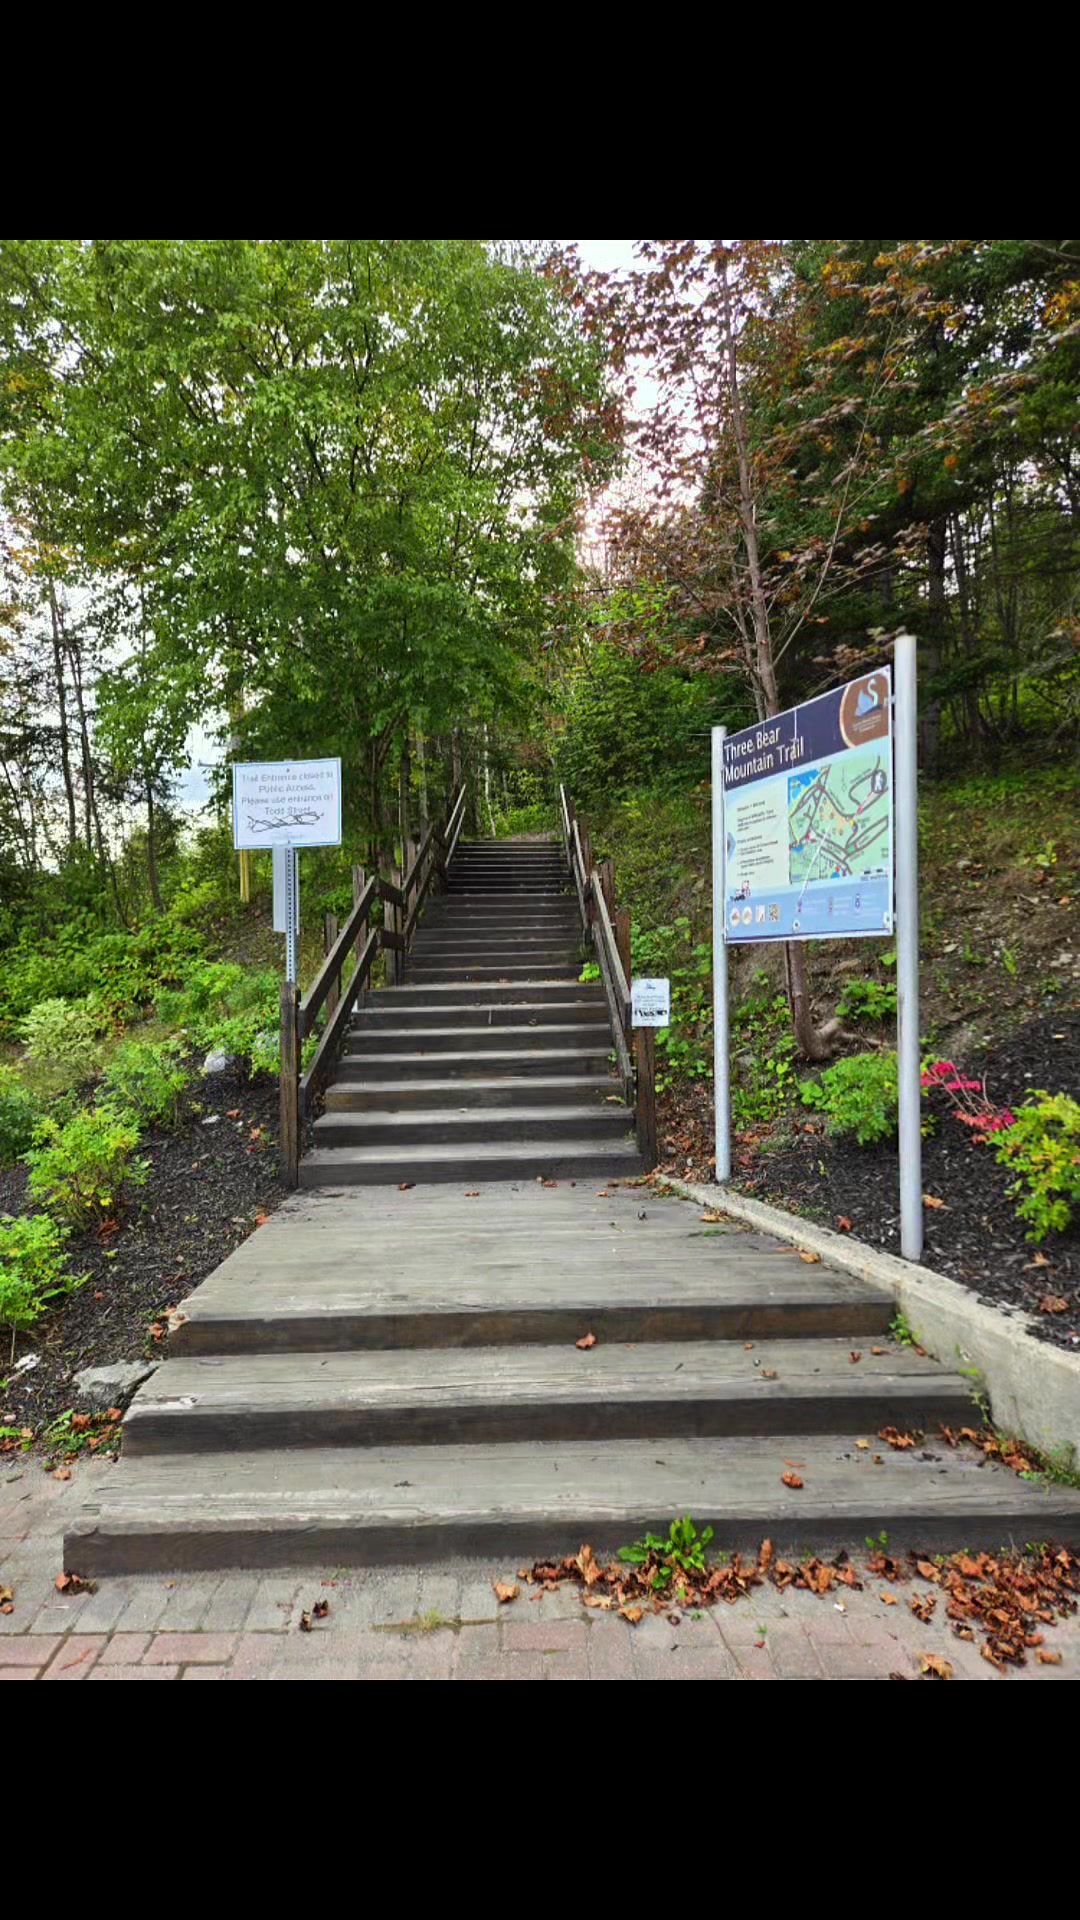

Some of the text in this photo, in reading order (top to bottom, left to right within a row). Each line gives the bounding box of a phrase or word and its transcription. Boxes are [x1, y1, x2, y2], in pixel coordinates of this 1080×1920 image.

[724, 727, 781, 761] Three Bear
[724, 736, 804, 783] Mountain Trail
